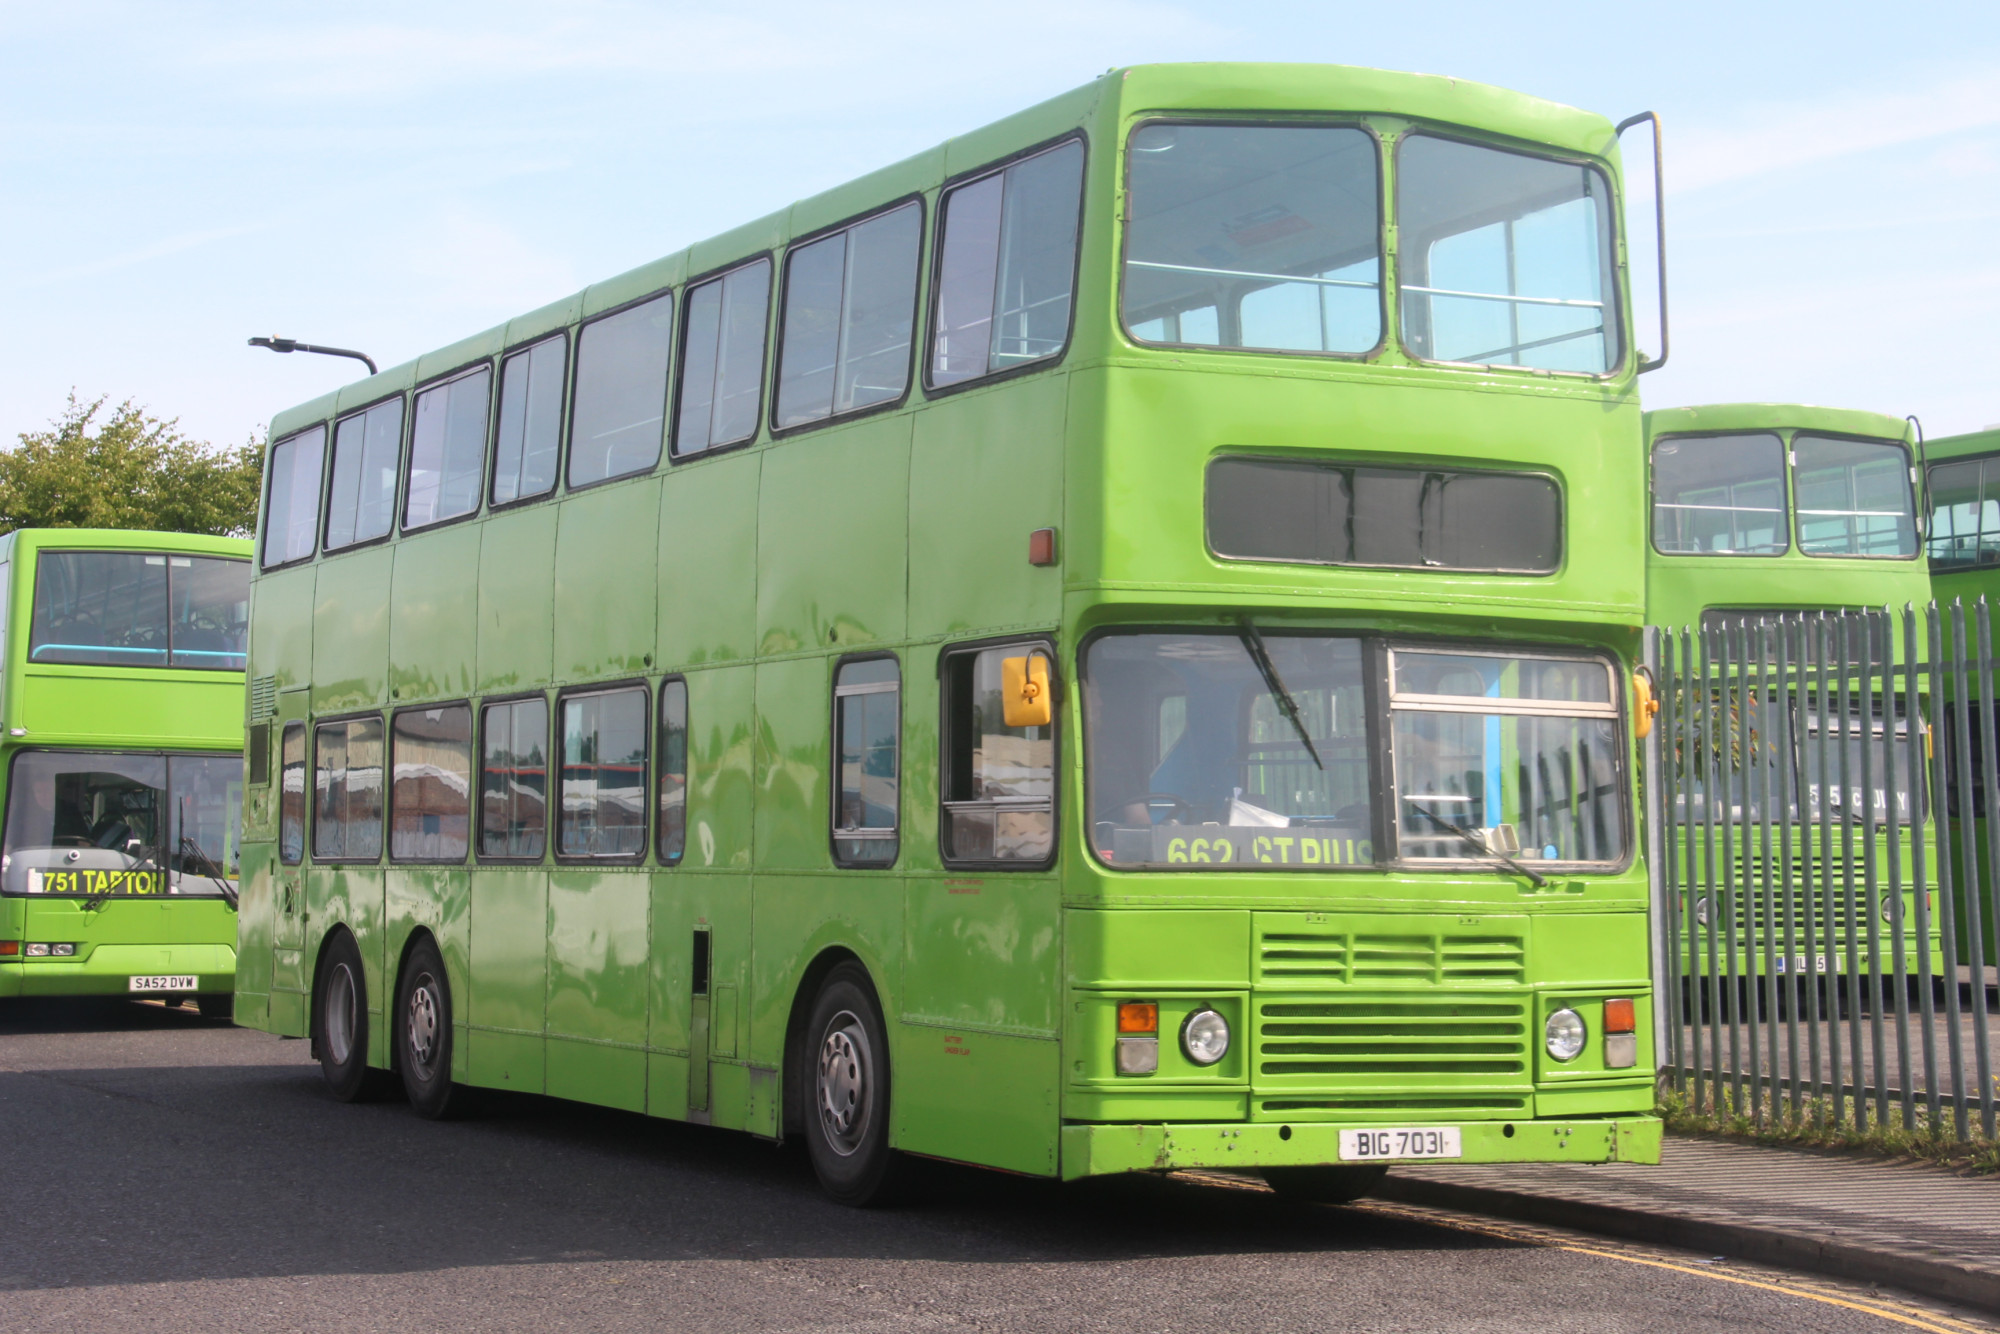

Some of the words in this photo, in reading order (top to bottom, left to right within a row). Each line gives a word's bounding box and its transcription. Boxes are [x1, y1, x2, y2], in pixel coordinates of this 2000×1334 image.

[1167, 837, 1232, 863] 662
[43, 871, 78, 892] 751
[135, 977, 167, 989] SA52
[170, 976, 193, 988] DVW
[1357, 1132, 1390, 1156] BIG
[1396, 1131, 1444, 1155] 7031
